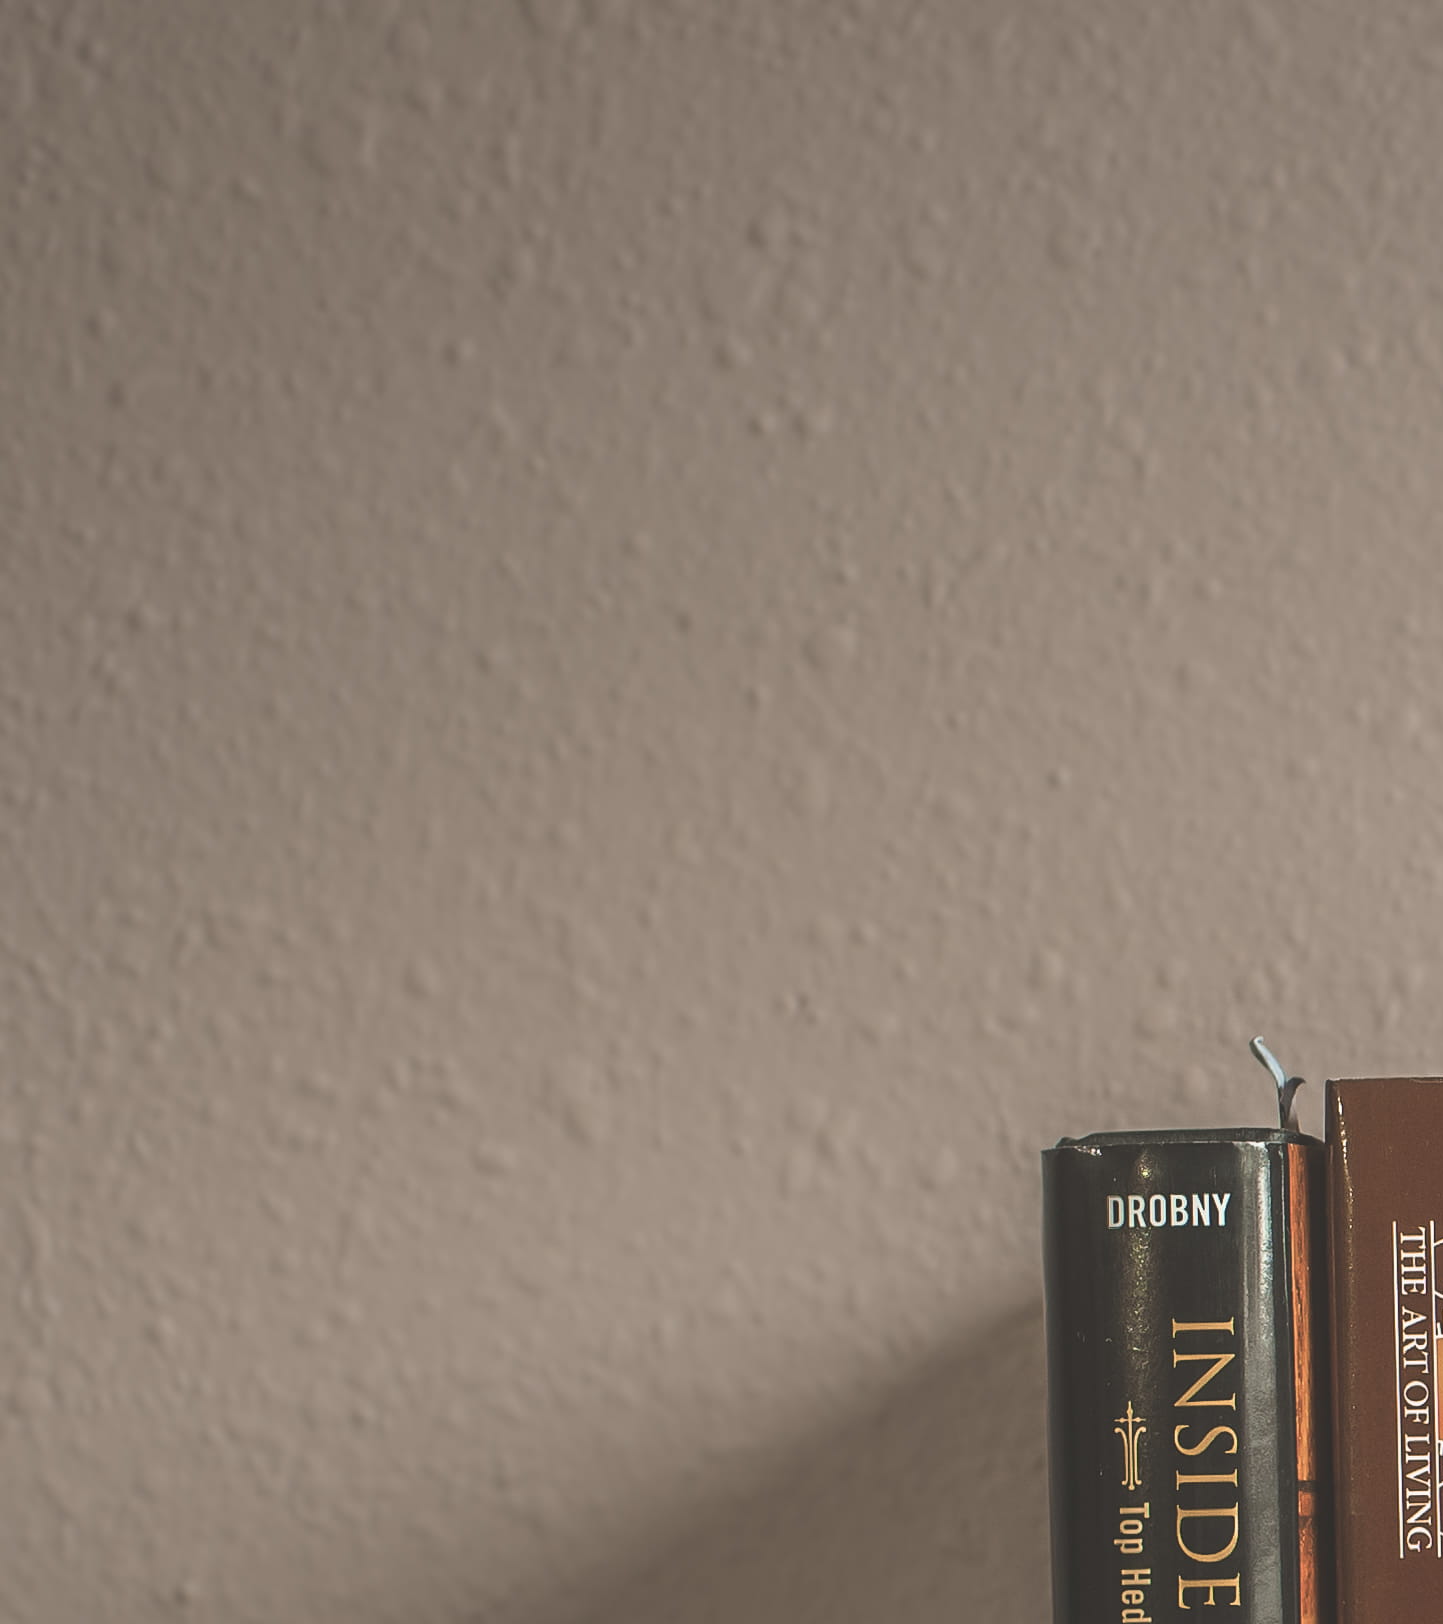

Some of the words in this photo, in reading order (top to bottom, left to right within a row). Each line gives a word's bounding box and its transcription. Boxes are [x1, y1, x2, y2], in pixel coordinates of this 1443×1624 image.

[1107, 1192, 1232, 1229] DROBNY
[1398, 1227, 1428, 1296] THE
[1400, 1306, 1429, 1375] ART
[1401, 1379, 1429, 1426] OF
[1170, 1315, 1242, 1611] INSIDE
[1402, 1432, 1433, 1554] LIVING
[1112, 1500, 1151, 1555] Top
